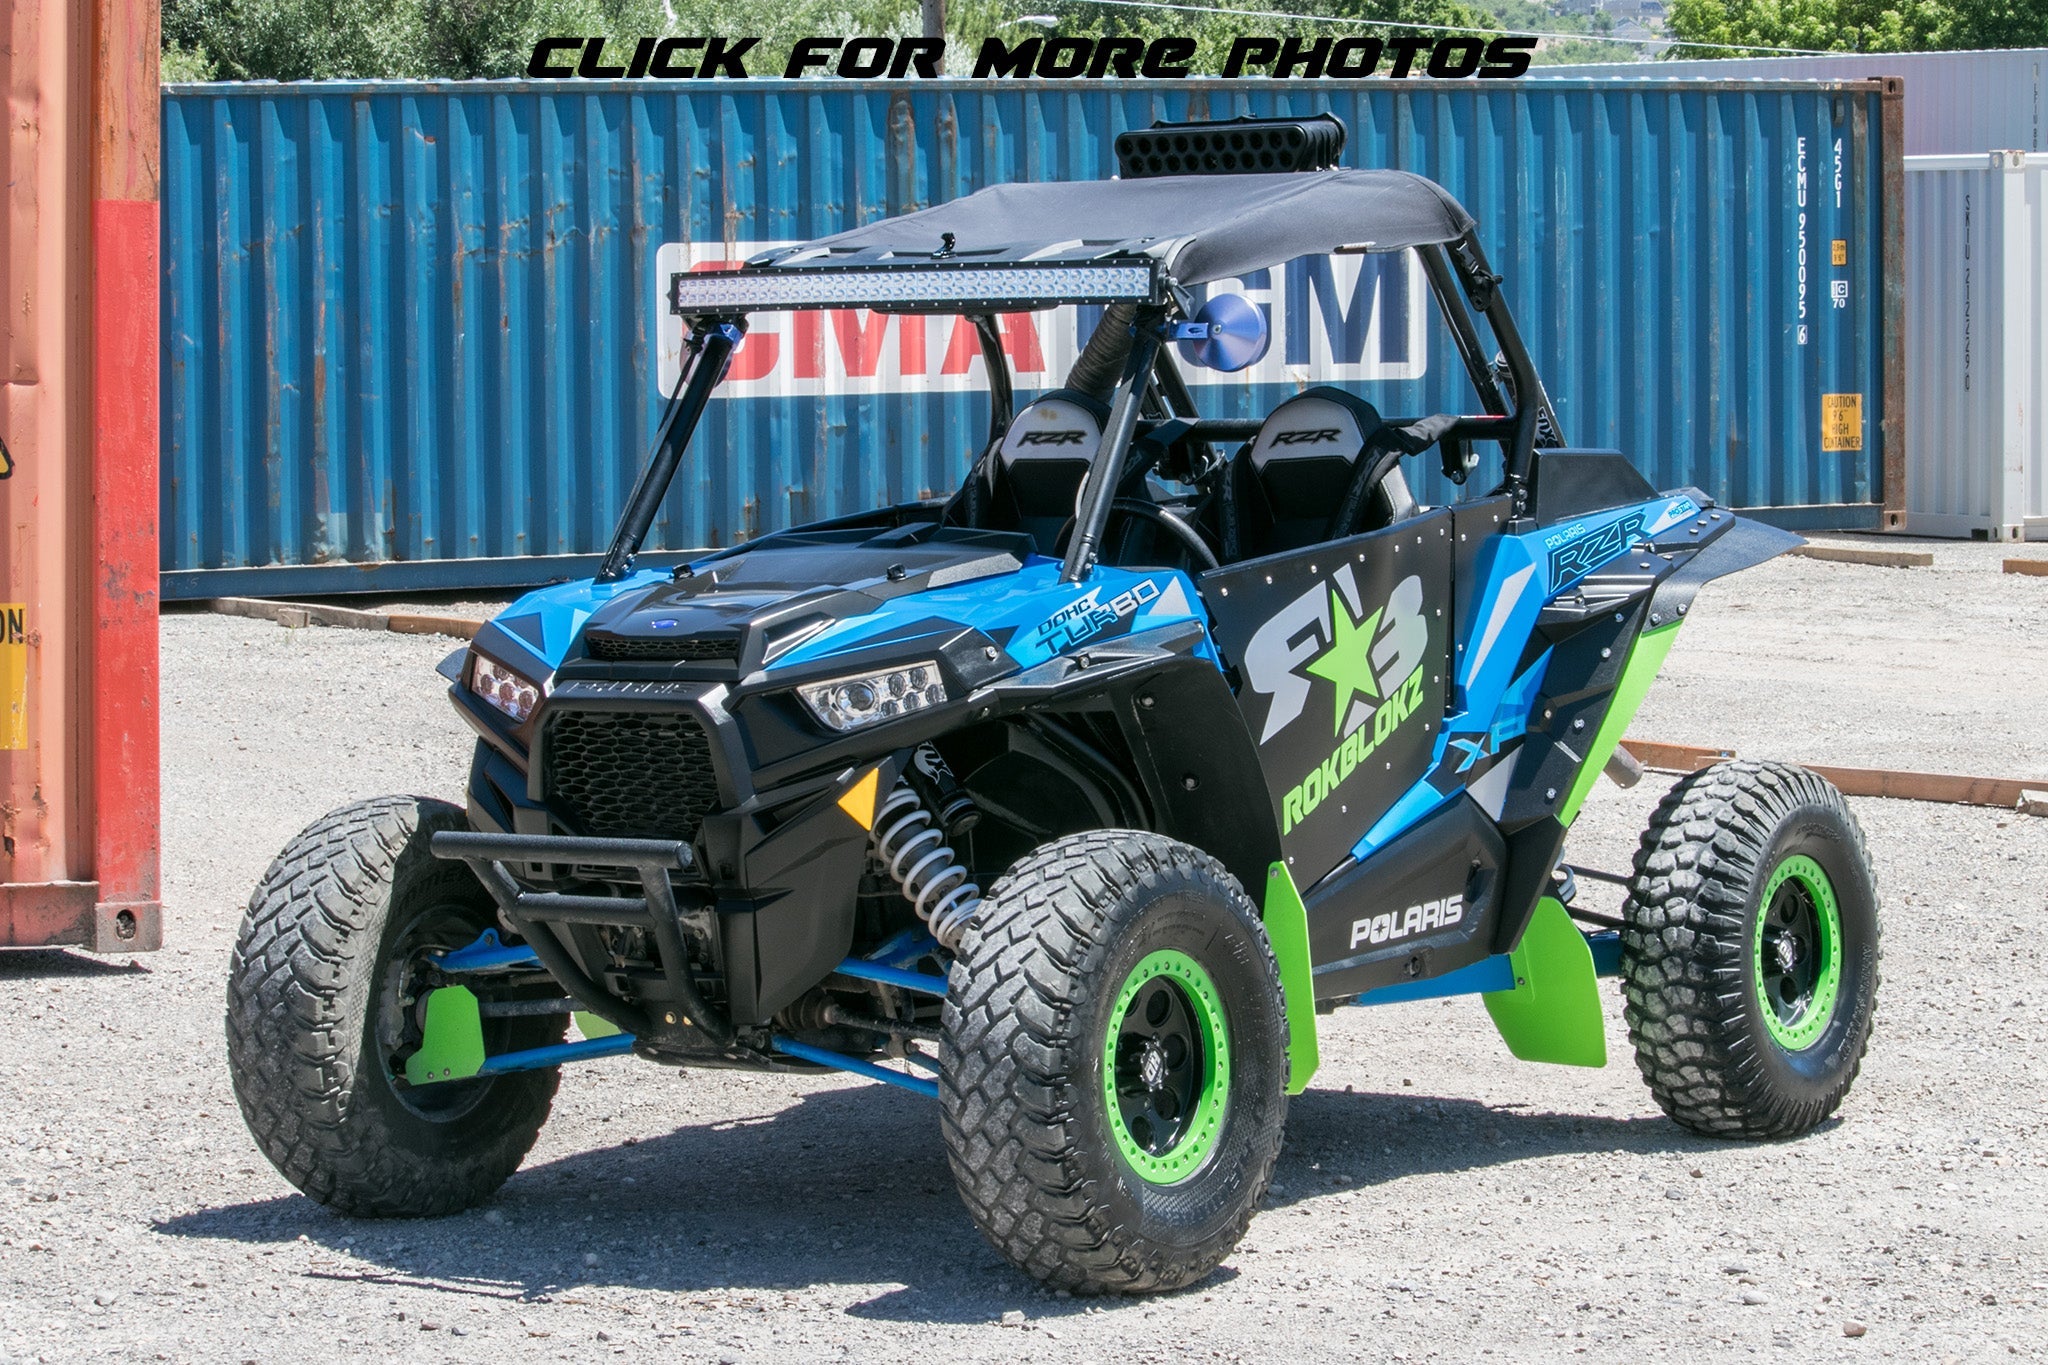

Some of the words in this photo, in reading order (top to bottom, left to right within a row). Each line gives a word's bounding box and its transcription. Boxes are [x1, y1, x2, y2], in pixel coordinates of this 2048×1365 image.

[1796, 137, 1806, 208] ECMU
[1834, 138, 1842, 208] 45G1
[1798, 213, 1806, 319] 950095
[1833, 298, 1846, 309] 70
[1017, 430, 1089, 449] RZR
[1268, 428, 1342, 449] RZR
[1544, 523, 1586, 549] POLARIS
[1549, 508, 1651, 593] RZR
[1035, 579, 1161, 657] TURBO
[1037, 598, 1090, 636] DOHC
[1282, 664, 1424, 836] ROKBLOKZ
[1448, 713, 1526, 774] XP
[1350, 894, 1463, 950] POLARIS
